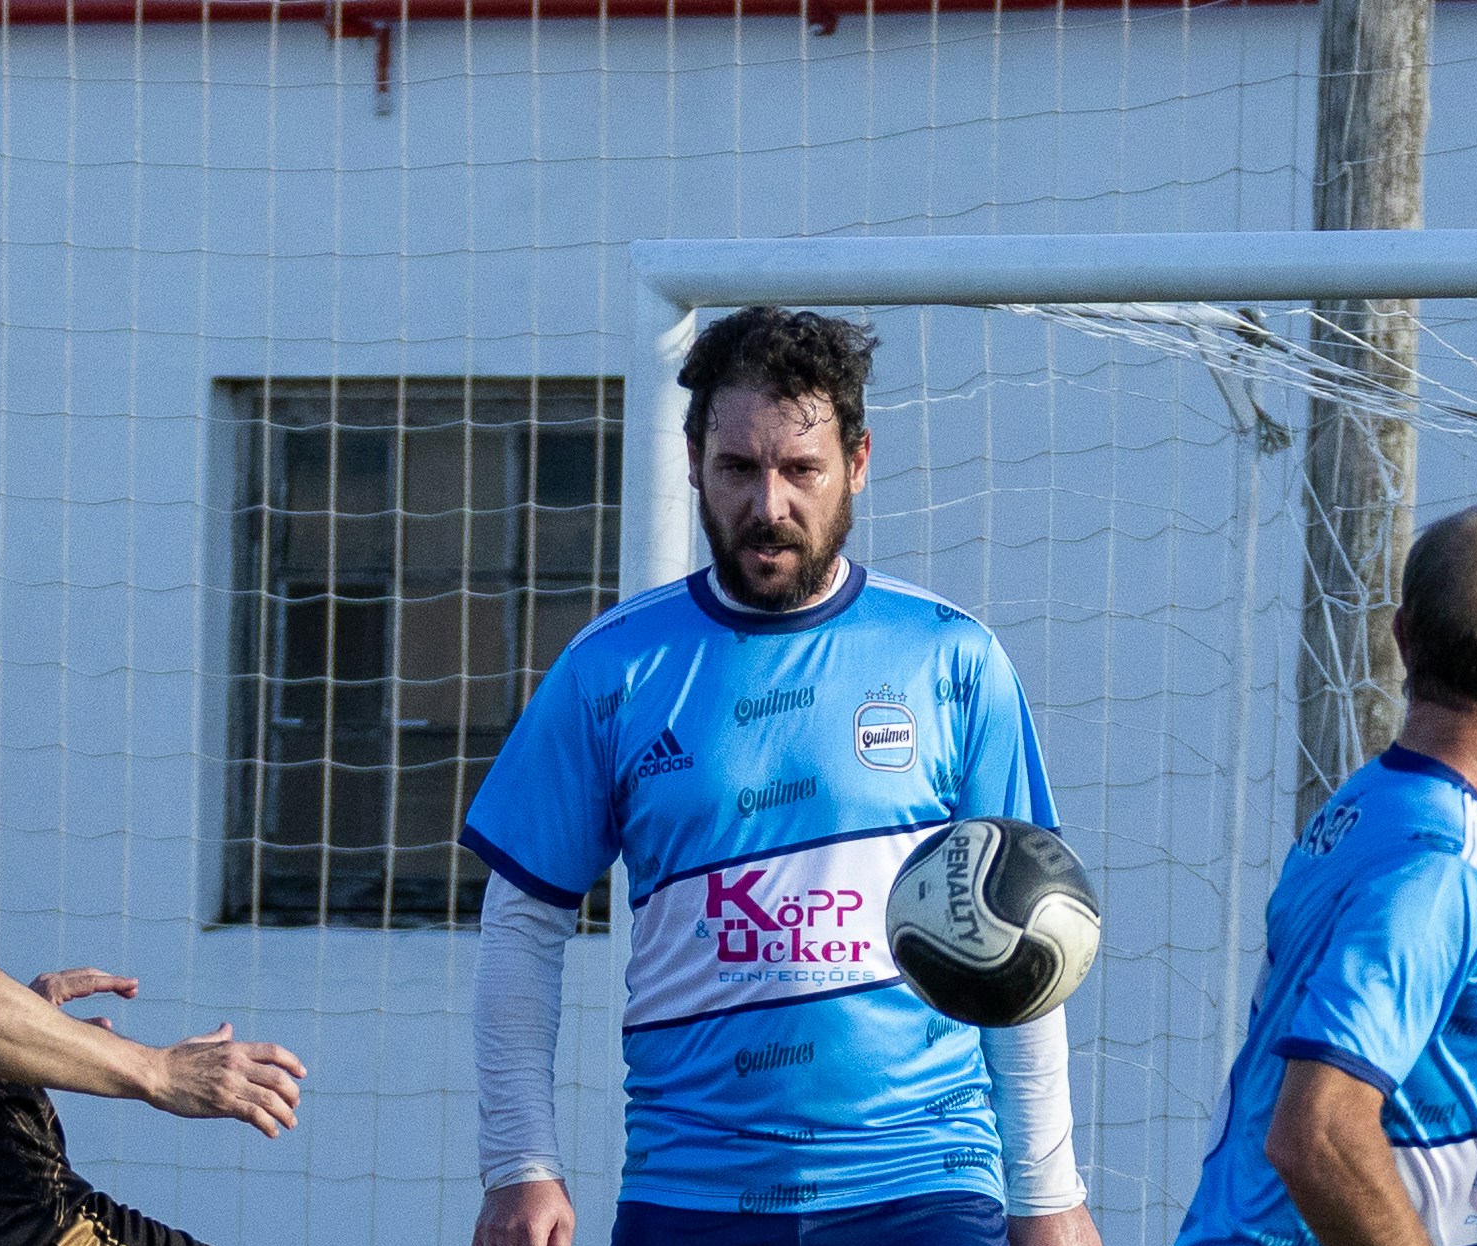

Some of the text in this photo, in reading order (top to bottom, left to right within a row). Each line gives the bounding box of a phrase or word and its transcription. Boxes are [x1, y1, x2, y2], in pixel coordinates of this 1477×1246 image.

[734, 686, 815, 727] Quilmes
[862, 727, 910, 749] Quilmes
[638, 752, 694, 778] adidas
[737, 776, 817, 819] Quilmes
[946, 836, 985, 945] PENALTY
[695, 918, 871, 963] & Ücker
[719, 966, 876, 987] CONFECÇÕES
[735, 1041, 815, 1078] Quilmes
